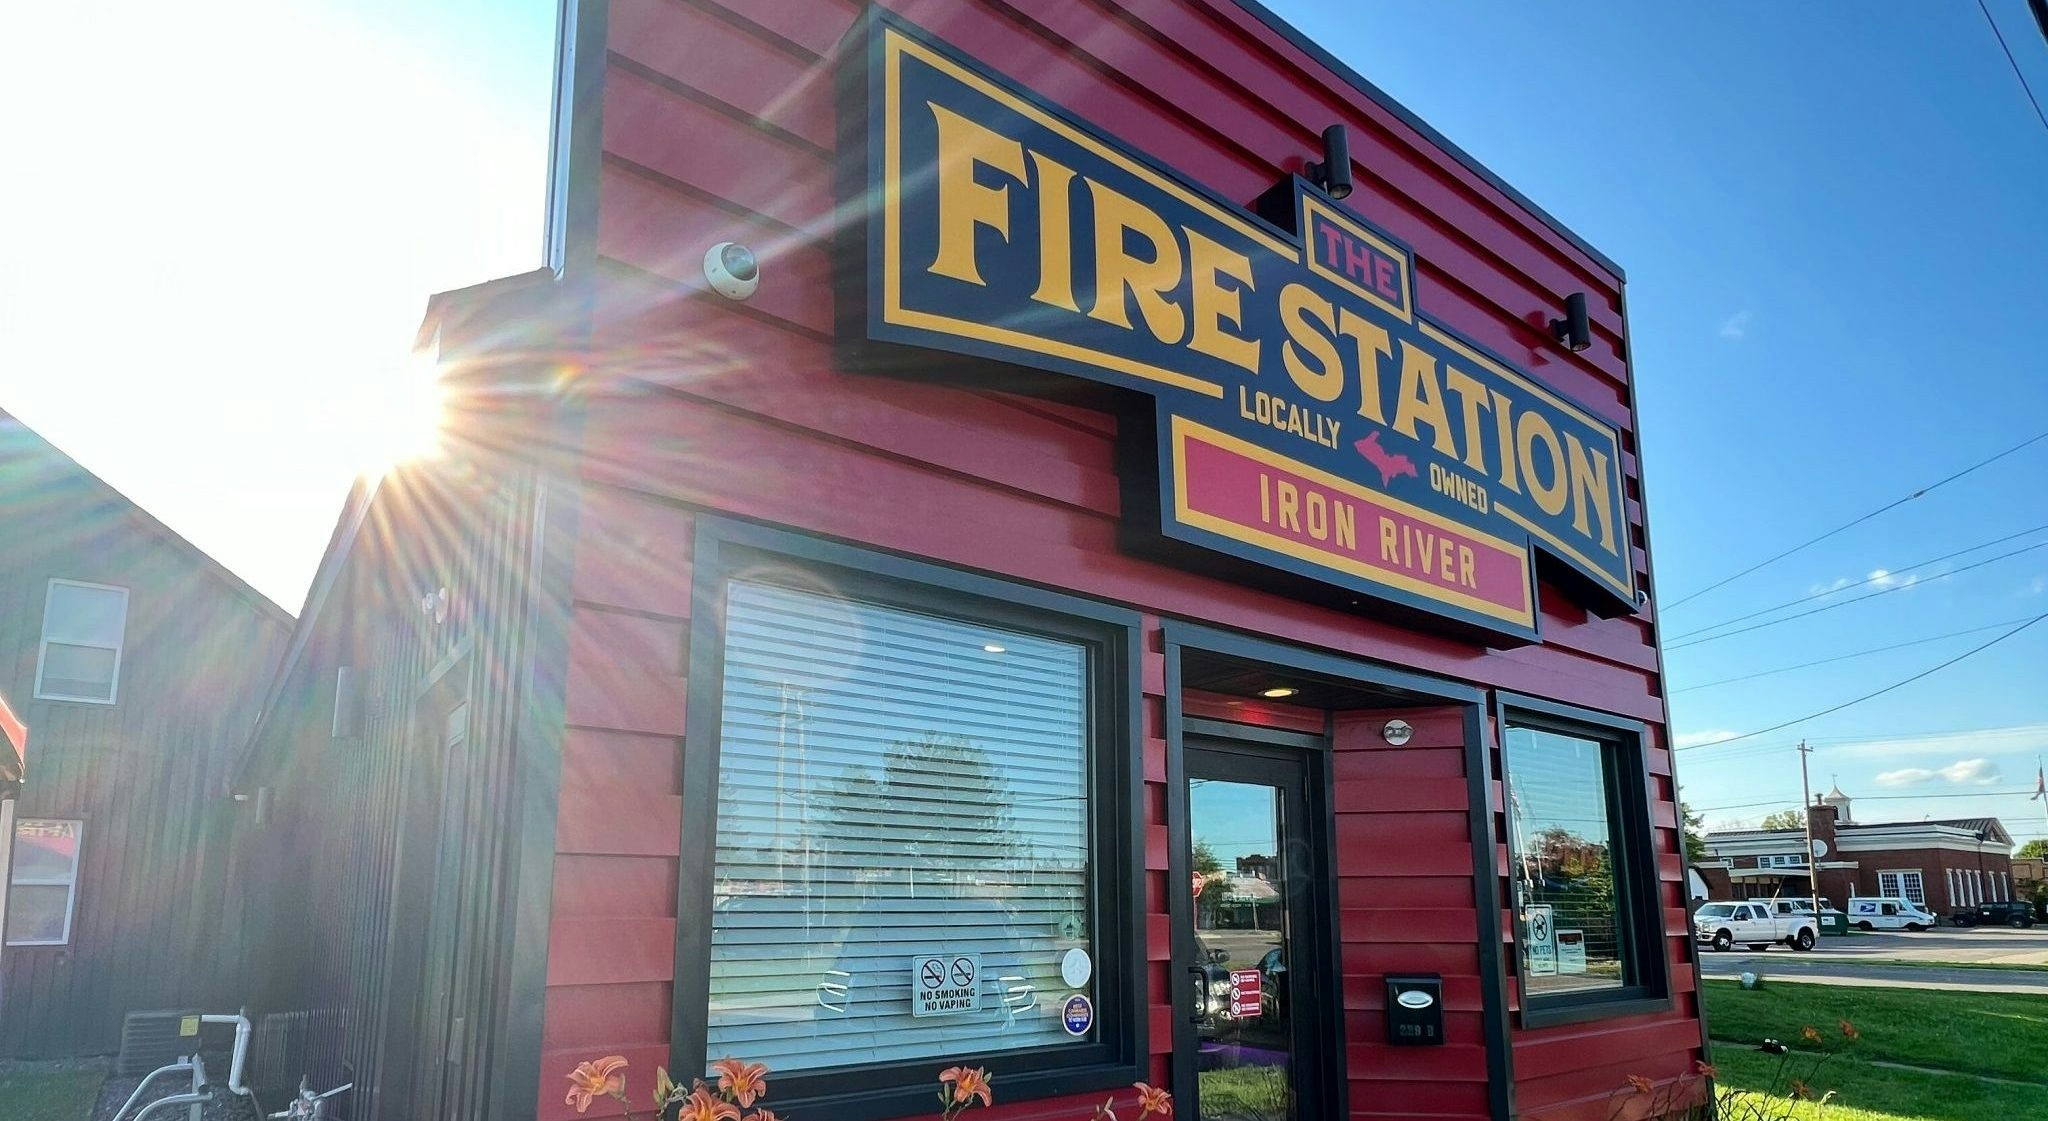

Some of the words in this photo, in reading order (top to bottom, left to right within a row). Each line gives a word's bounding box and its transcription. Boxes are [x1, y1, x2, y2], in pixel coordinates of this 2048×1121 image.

[1319, 222, 1398, 300] THE
[926, 100, 1261, 375] FIRE
[1279, 283, 1619, 557] STATION
[1239, 385, 1341, 450] LOCALLY
[1429, 462, 1488, 515] OWNED
[1260, 473, 1356, 551] IRON
[1379, 515, 1477, 590] RIVER
[920, 991, 932, 1000] NO
[935, 988, 975, 999] SMOKING
[925, 1001, 937, 1011] NO
[939, 999, 971, 1009] VAPING
